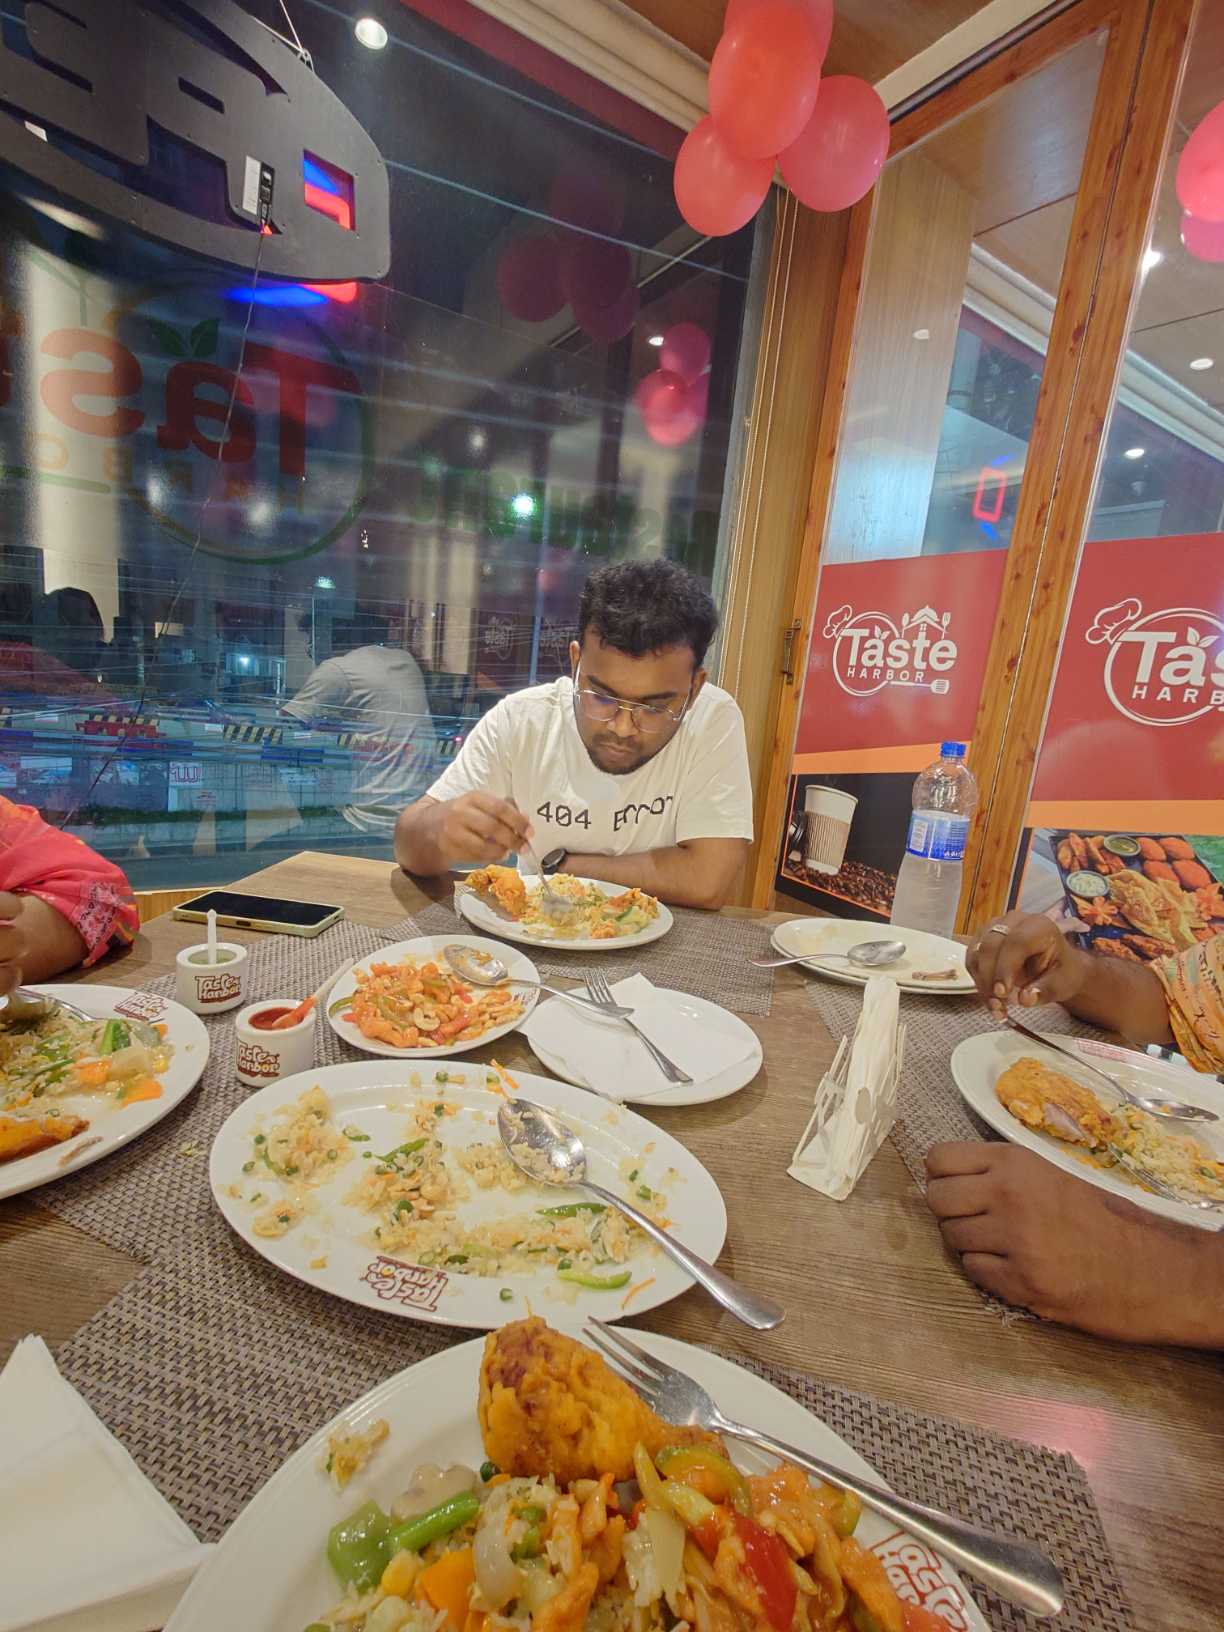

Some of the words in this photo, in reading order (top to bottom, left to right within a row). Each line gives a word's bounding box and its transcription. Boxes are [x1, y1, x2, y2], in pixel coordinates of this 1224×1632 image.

[840, 628, 957, 671] Taste
[847, 667, 925, 682] HARBOR
[537, 801, 591, 829] 404
[614, 796, 673, 831] Error
[195, 973, 240, 991] Taste
